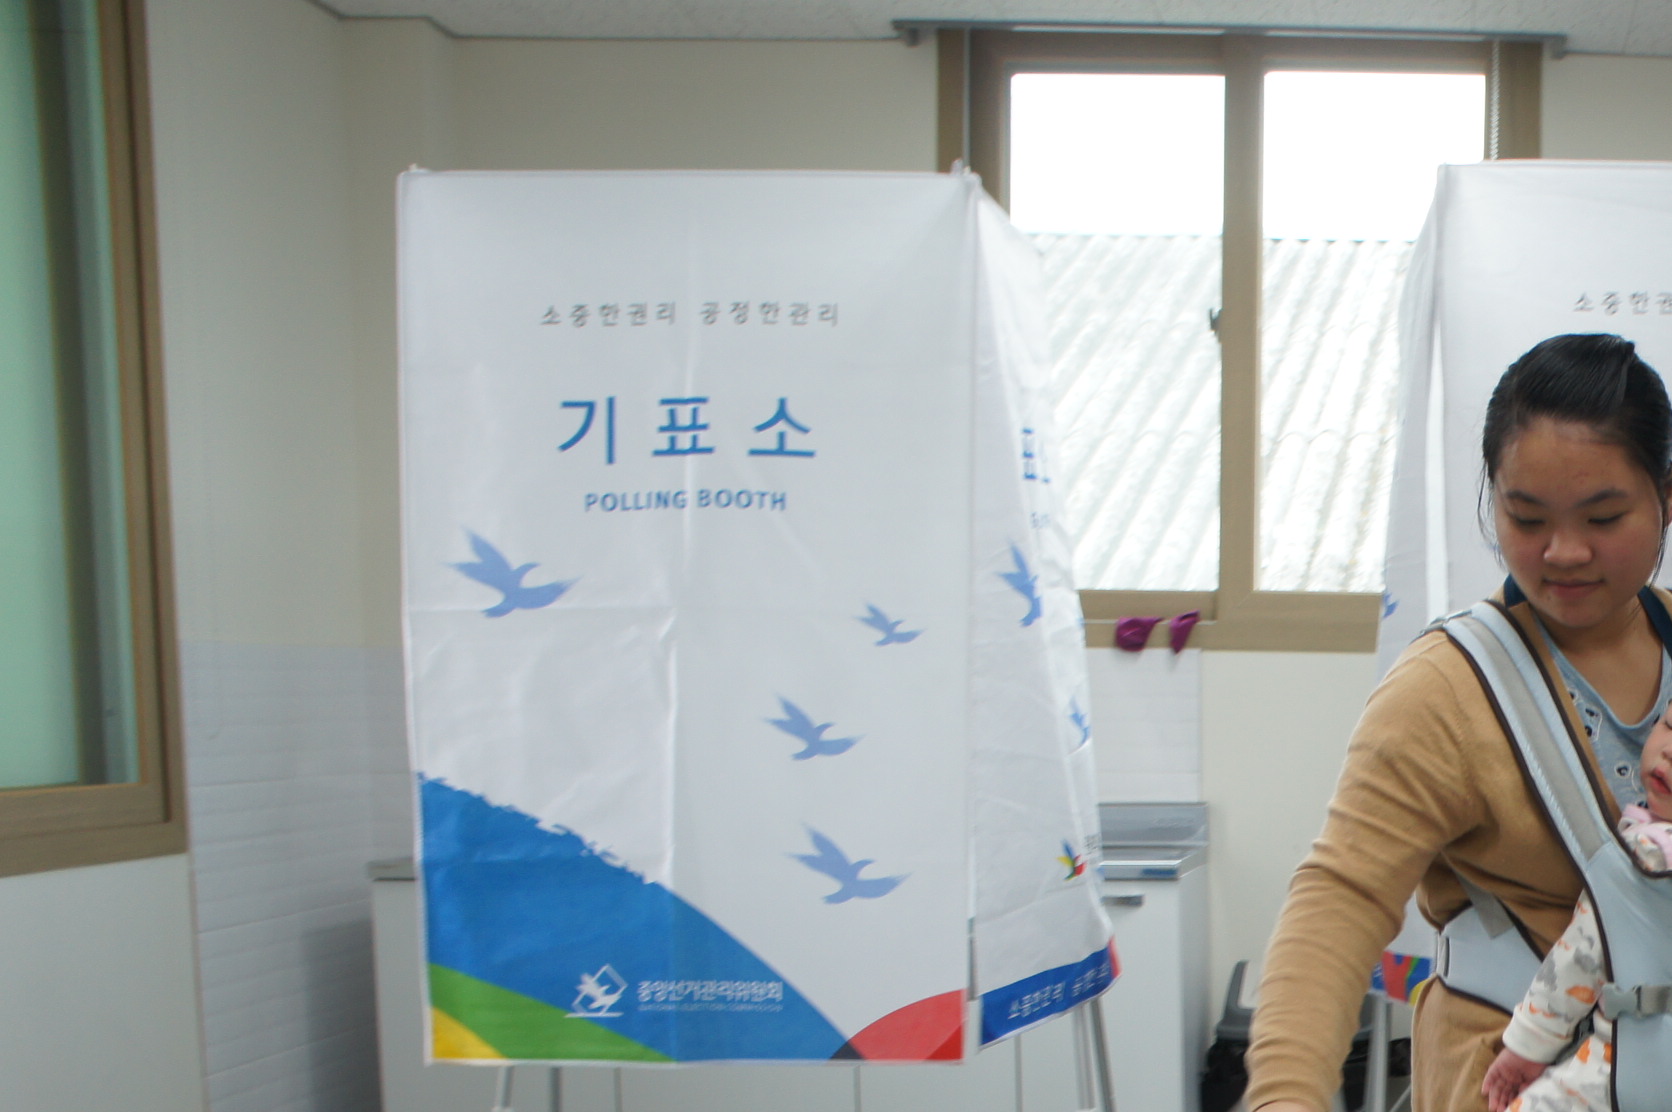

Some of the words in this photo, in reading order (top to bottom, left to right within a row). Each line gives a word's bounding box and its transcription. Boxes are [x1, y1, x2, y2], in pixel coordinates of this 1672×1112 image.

[541, 302, 676, 328] 소중한권리
[700, 301, 839, 327] 공정한관리
[557, 396, 816, 465] 기표소
[584, 490, 689, 513] POLLING
[696, 488, 787, 512] BOOTH
